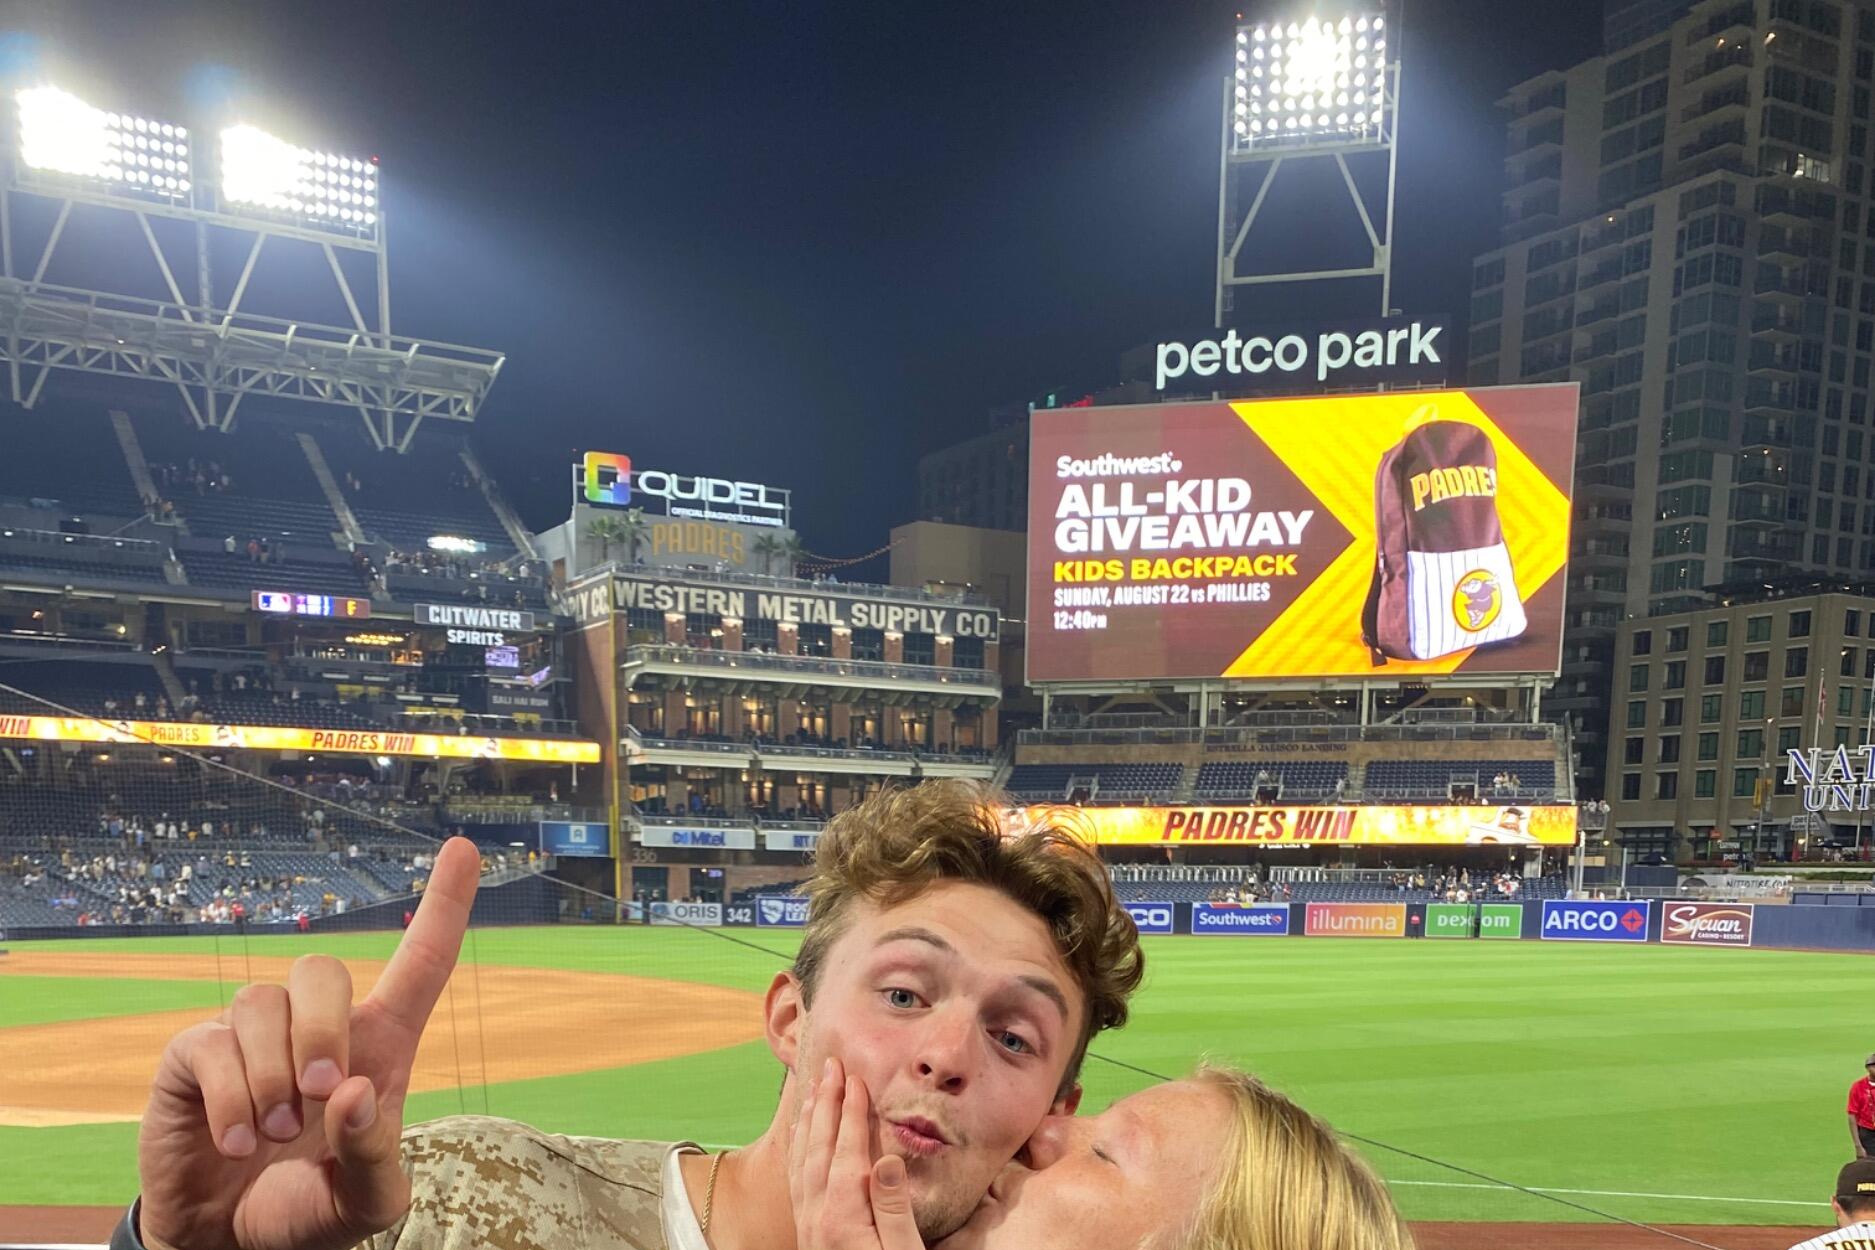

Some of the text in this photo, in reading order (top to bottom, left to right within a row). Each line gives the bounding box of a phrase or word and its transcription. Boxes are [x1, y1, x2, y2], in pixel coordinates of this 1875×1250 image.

[1156, 323, 1443, 390] petco park
[1057, 452, 1172, 477] Southwest
[638, 470, 784, 510] QUIDEL
[1055, 478, 1252, 519] ALL-KID
[653, 522, 745, 565] PADRES
[1055, 511, 1315, 553] GIVEAWAY
[1054, 554, 1299, 583] KIDS BACKPACK
[1054, 587, 1111, 608] SUNDAY,
[1114, 584, 1169, 605] AUGUST
[1171, 585, 1190, 604] 22
[1207, 582, 1271, 602] PHILLIES
[429, 605, 521, 629] CUTWATER
[614, 581, 996, 638] WESTERN METAL SUPPLY CO.
[447, 629, 504, 646] SPIRITS
[150, 727, 199, 742] PADRES
[312, 732, 415, 752] PADRES WIN
[1258, 743, 1298, 752] JALISCO
[1302, 743, 1347, 752] LANDING
[1163, 810, 1358, 841] PADRES WIN
[691, 831, 725, 847] Mitel
[675, 905, 718, 918] ORIS
[727, 908, 752, 922] 342
[1199, 911, 1271, 927] Southwest
[1312, 910, 1398, 930] illumina
[1437, 914, 1510, 928] Dexom
[1545, 910, 1618, 931] ARCO
[1668, 906, 1742, 940] Sycuan
